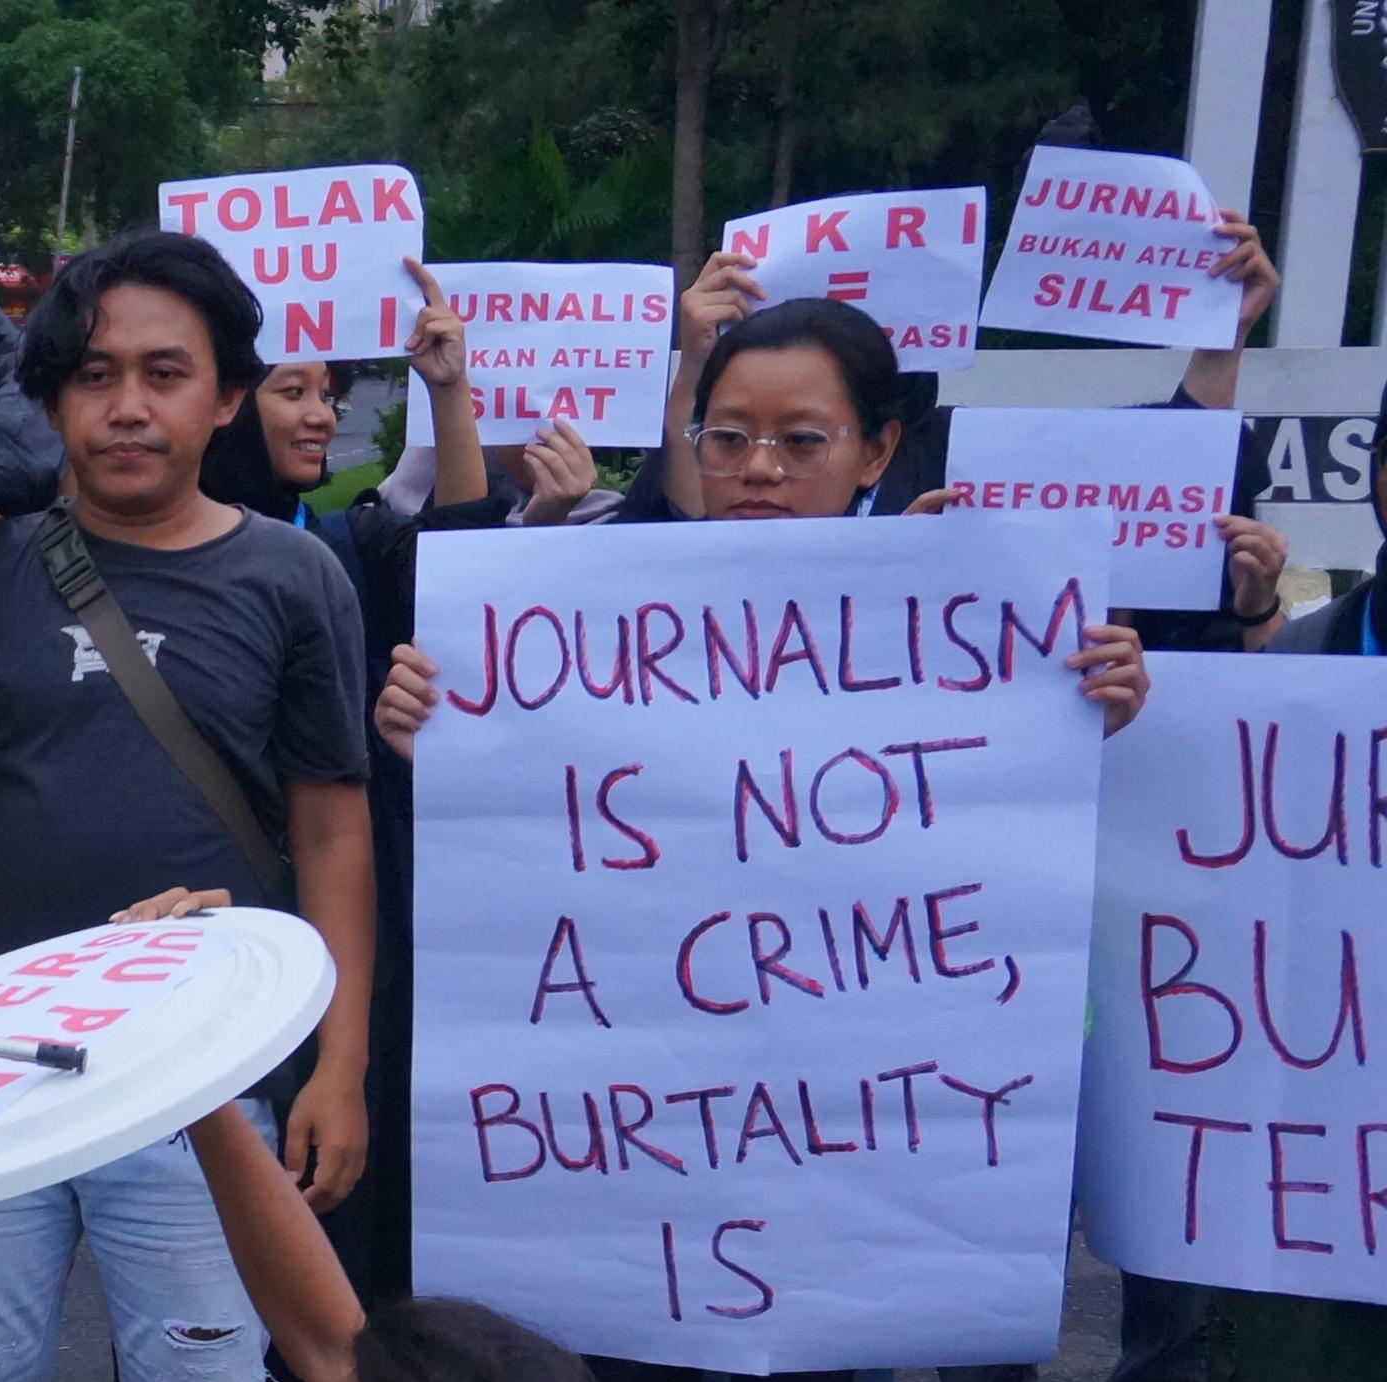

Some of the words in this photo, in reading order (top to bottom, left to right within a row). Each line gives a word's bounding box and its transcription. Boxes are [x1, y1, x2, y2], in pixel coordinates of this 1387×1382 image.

[168, 178, 415, 237] TOLAK
[253, 243, 337, 285] UU
[1018, 234, 1126, 261] BUKAN
[450, 293, 668, 323] URNALIS
[1034, 273, 1191, 319] SILAT
[470, 348, 536, 368] KAN
[550, 348, 654, 368] ATLET
[1255, 417, 1375, 501] AS
[951, 482, 1225, 514] REFORMASI
[445, 577, 1087, 718] JOURNALISM
[564, 762, 662, 873] IS
[734, 735, 988, 863] NOT
[529, 914, 612, 1029] A
[674, 882, 1021, 1015] CRIME,
[1140, 912, 1366, 1074] BU
[468, 1060, 1033, 1183] BURTALITY
[659, 1217, 774, 1322] IS
